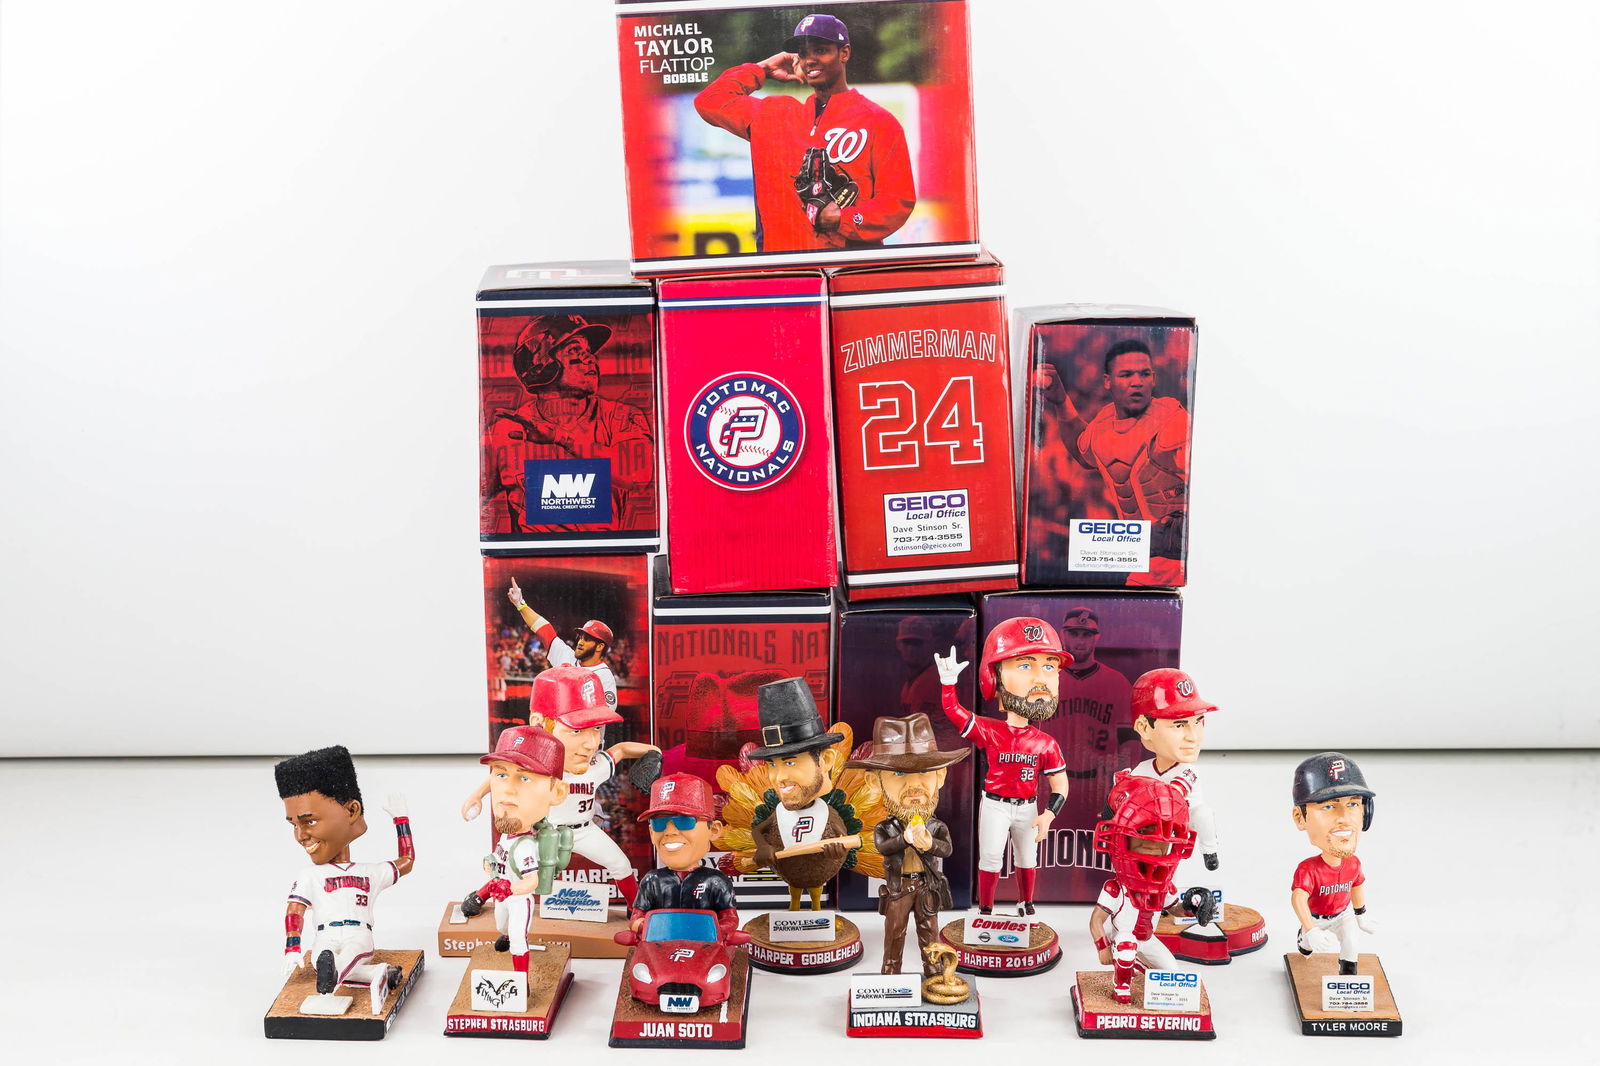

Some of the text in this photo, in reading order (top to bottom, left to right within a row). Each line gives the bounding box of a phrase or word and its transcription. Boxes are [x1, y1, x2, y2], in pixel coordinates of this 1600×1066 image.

[634, 22, 702, 38] MICHAEL
[634, 38, 714, 56] TAYLOR
[640, 56, 715, 74] FLATTOP
[663, 72, 709, 84] BOBBLE
[840, 328, 996, 374] ZIMMERMAN
[696, 380, 790, 418] POTOMAC
[858, 376, 984, 470] 24
[696, 440, 794, 482] NATIONALS
[541, 473, 596, 498] NW
[540, 498, 596, 506] NORTHWEST
[888, 494, 966, 512] GEICO
[906, 509, 966, 520] Local Office
[1078, 522, 1142, 534] GEICO
[893, 533, 963, 543] 703-754-3555
[893, 542, 962, 551] dstinson@geico.com
[657, 628, 776, 666] NATIONALS
[999, 752, 1038, 767] POTOMAC
[1020, 768, 1034, 781] 32
[578, 798, 594, 813] 37
[562, 868, 638, 882] HARPR
[356, 894, 368, 906] 33
[558, 888, 588, 898] New
[544, 898, 601, 906] Dominion
[972, 918, 1028, 932] Cowles
[754, 946, 794, 966] HARPER
[801, 942, 860, 966] GOBBLEHEAD
[964, 952, 1002, 968] HARPER
[1005, 956, 1034, 968] 2015
[1036, 949, 1051, 964] MVP
[1149, 972, 1197, 982] GEICO
[1327, 982, 1370, 990] GEICO
[475, 982, 500, 1008] FLYING
[667, 997, 693, 1007] NW
[447, 1018, 545, 1032] STEPHEN STRASBURG
[853, 1012, 976, 1029] INDIANA STRASBURG
[1096, 1016, 1200, 1031] PEDRO SEVERINO
[1312, 1023, 1388, 1032] TYLER MOORE
[639, 1023, 713, 1038] JUAN SOTO
